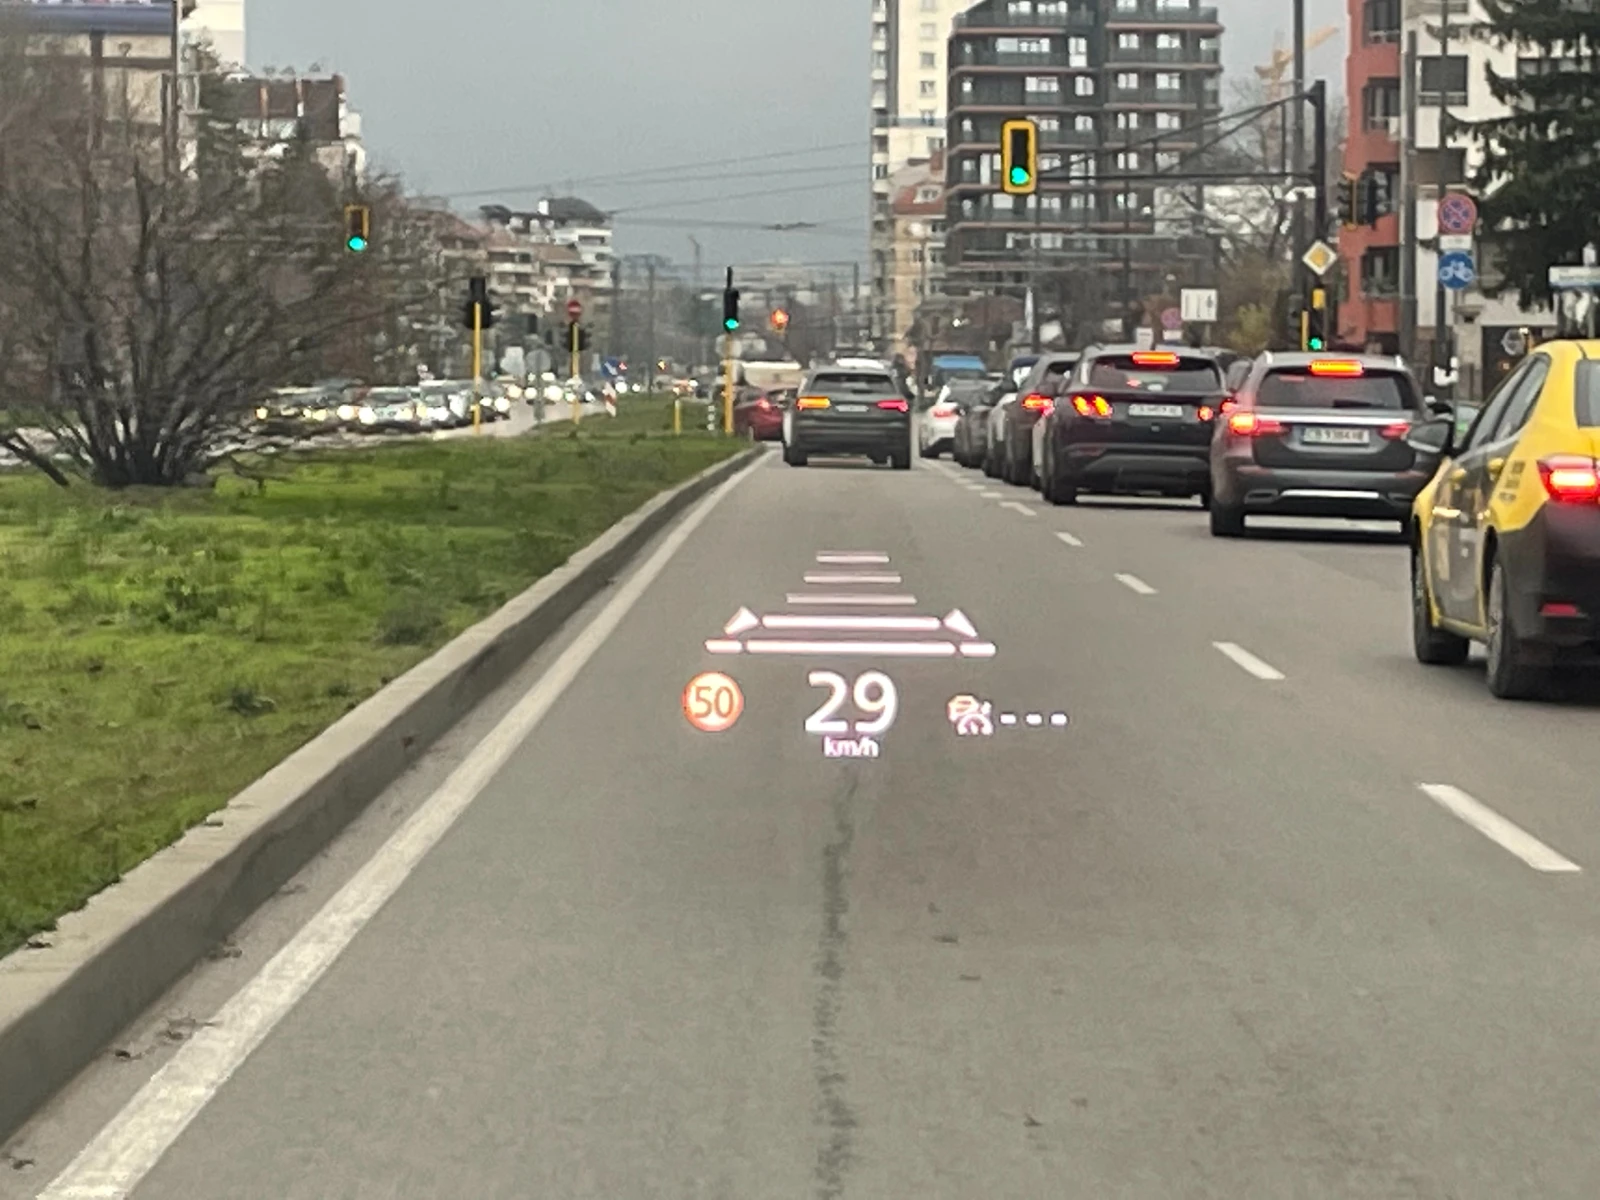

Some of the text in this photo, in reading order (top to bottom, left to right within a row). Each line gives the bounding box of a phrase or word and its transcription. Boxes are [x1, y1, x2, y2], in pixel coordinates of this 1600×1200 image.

[694, 686, 734, 719] 50
[804, 670, 898, 733] 29
[823, 735, 879, 758] km/h
